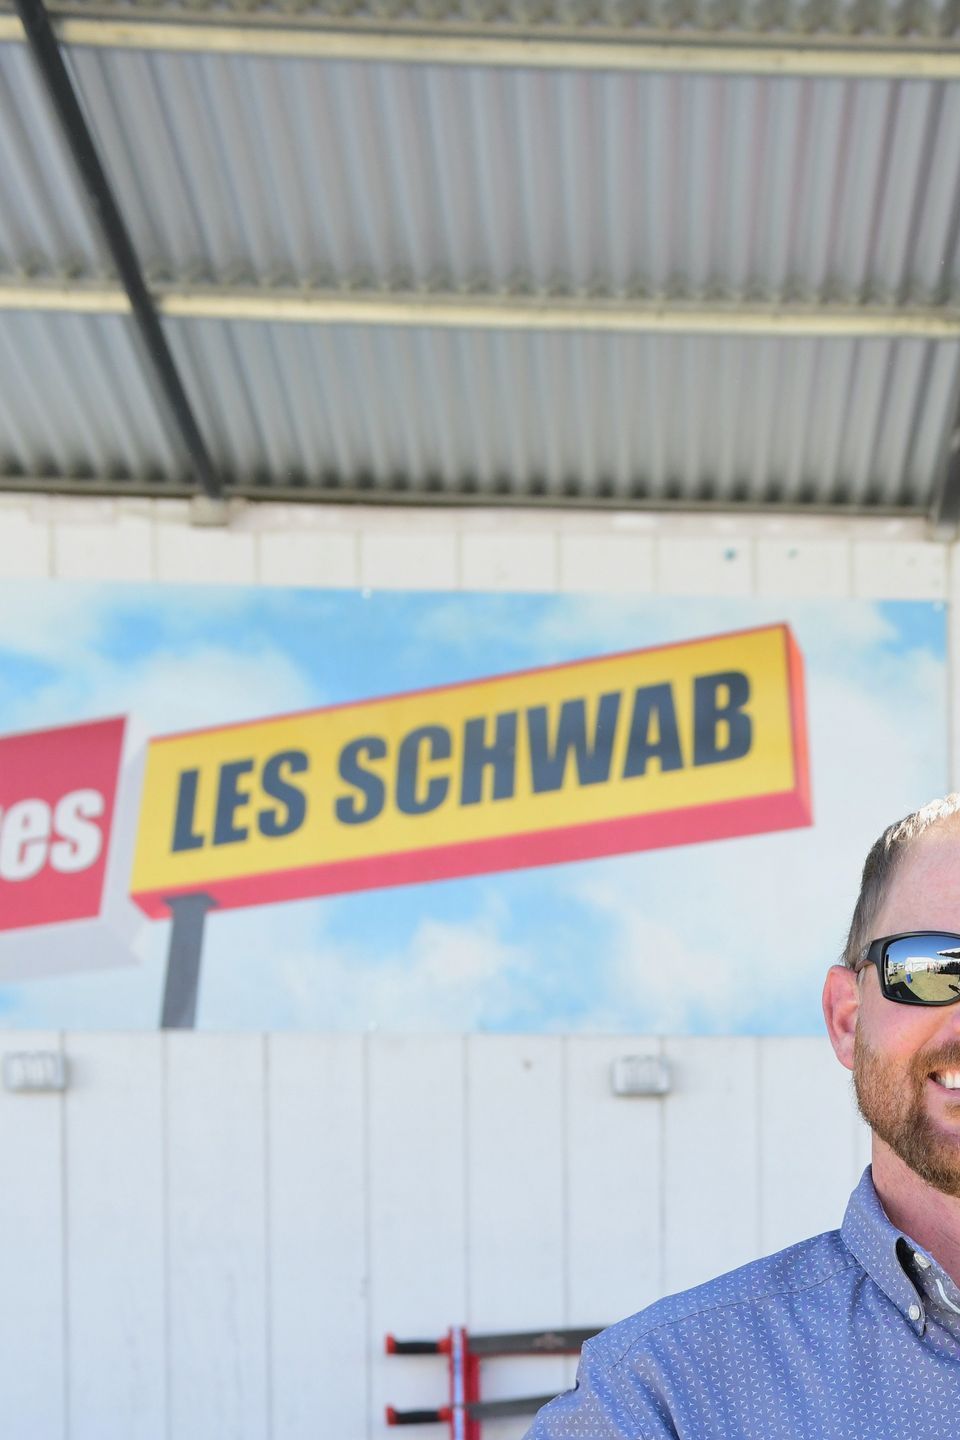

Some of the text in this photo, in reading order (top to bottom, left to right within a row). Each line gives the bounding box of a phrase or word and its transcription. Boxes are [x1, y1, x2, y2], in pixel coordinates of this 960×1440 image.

[171, 669, 754, 854] LES SCHWAB
[0, 788, 105, 882] es
